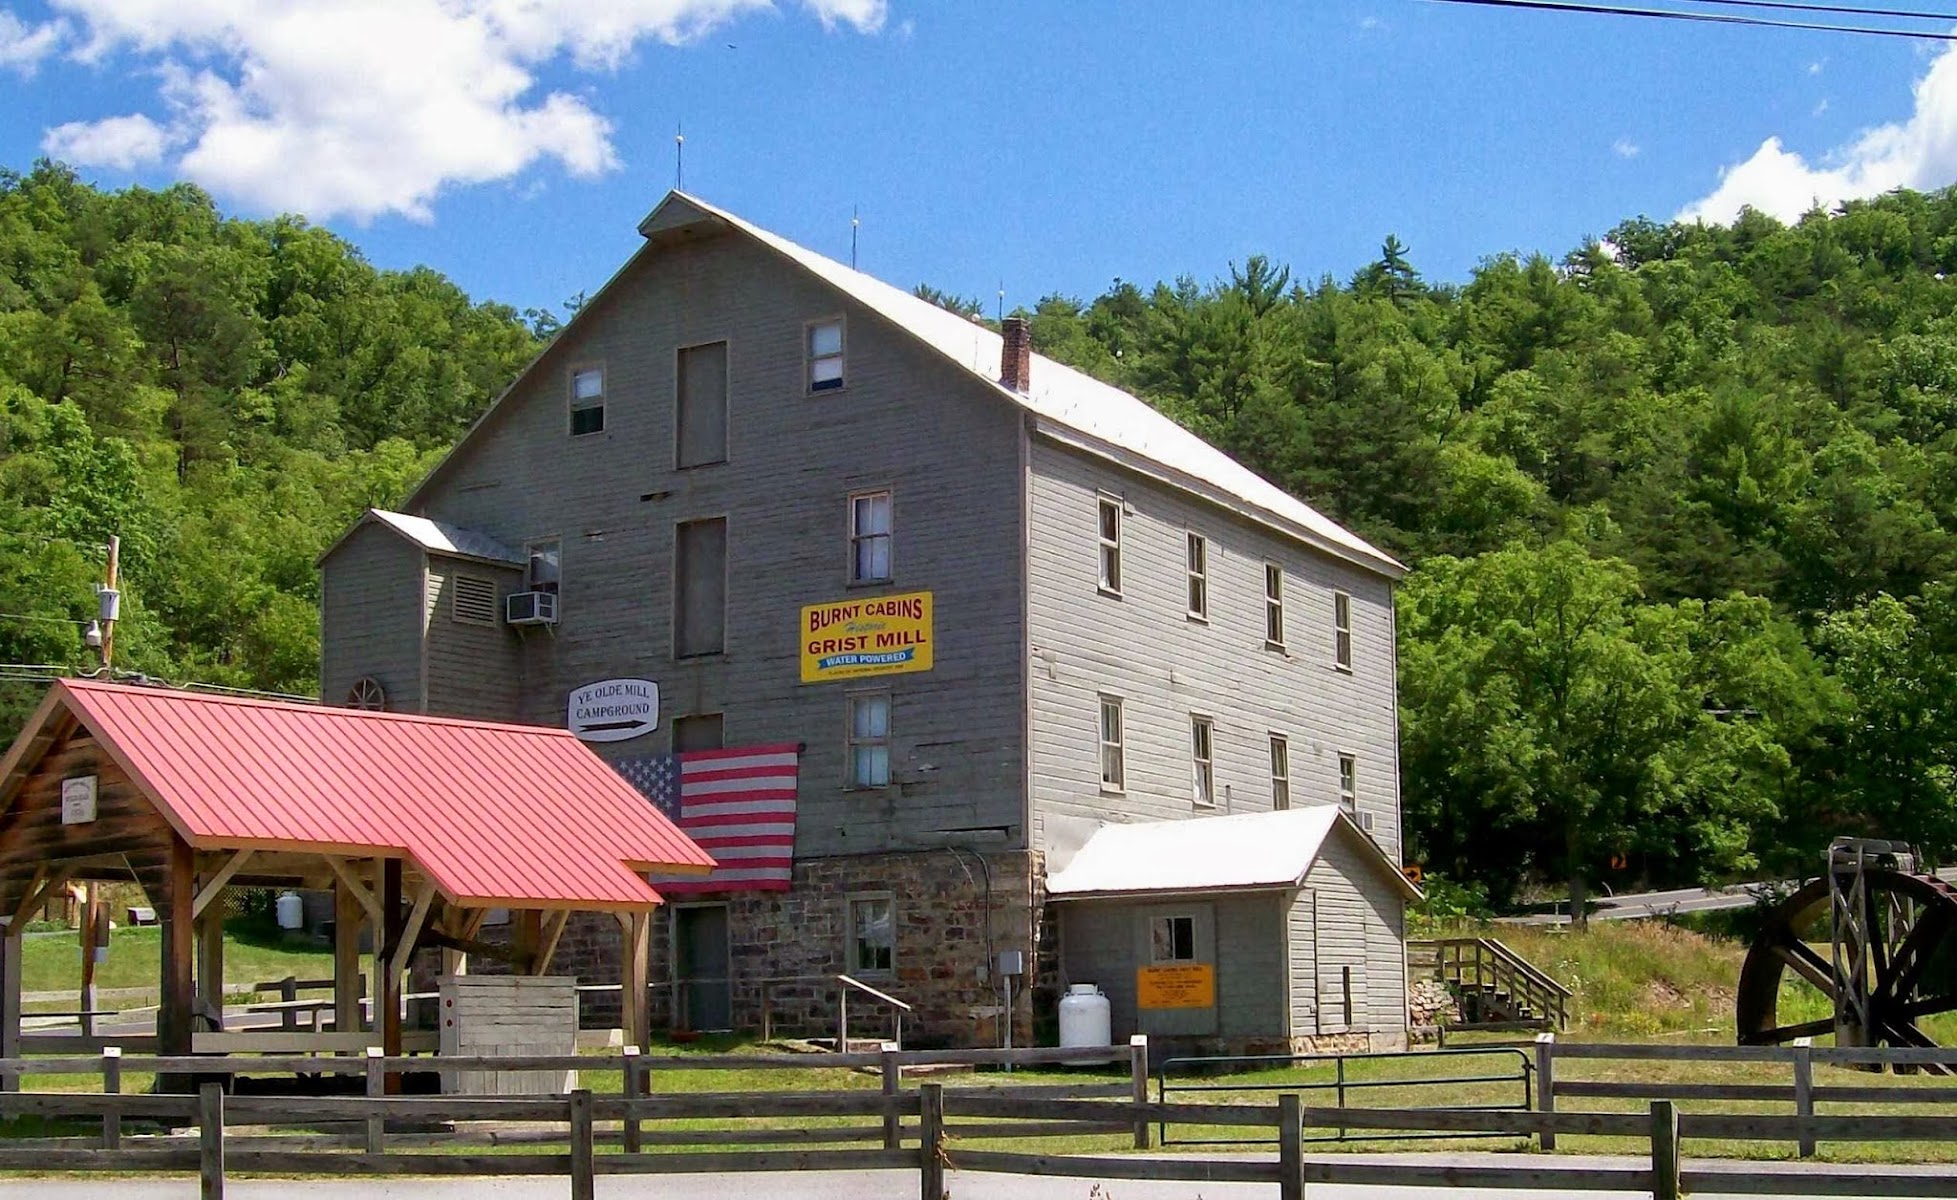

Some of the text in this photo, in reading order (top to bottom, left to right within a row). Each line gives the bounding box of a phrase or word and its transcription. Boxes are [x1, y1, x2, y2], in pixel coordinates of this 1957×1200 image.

[810, 598, 923, 633] BURNT CABINS
[808, 629, 927, 655] GRIST MILL
[826, 652, 906, 667] WATER POWERED
[578, 684, 650, 705] YE OLDE MILL
[576, 703, 650, 719] CAMPGROUND
